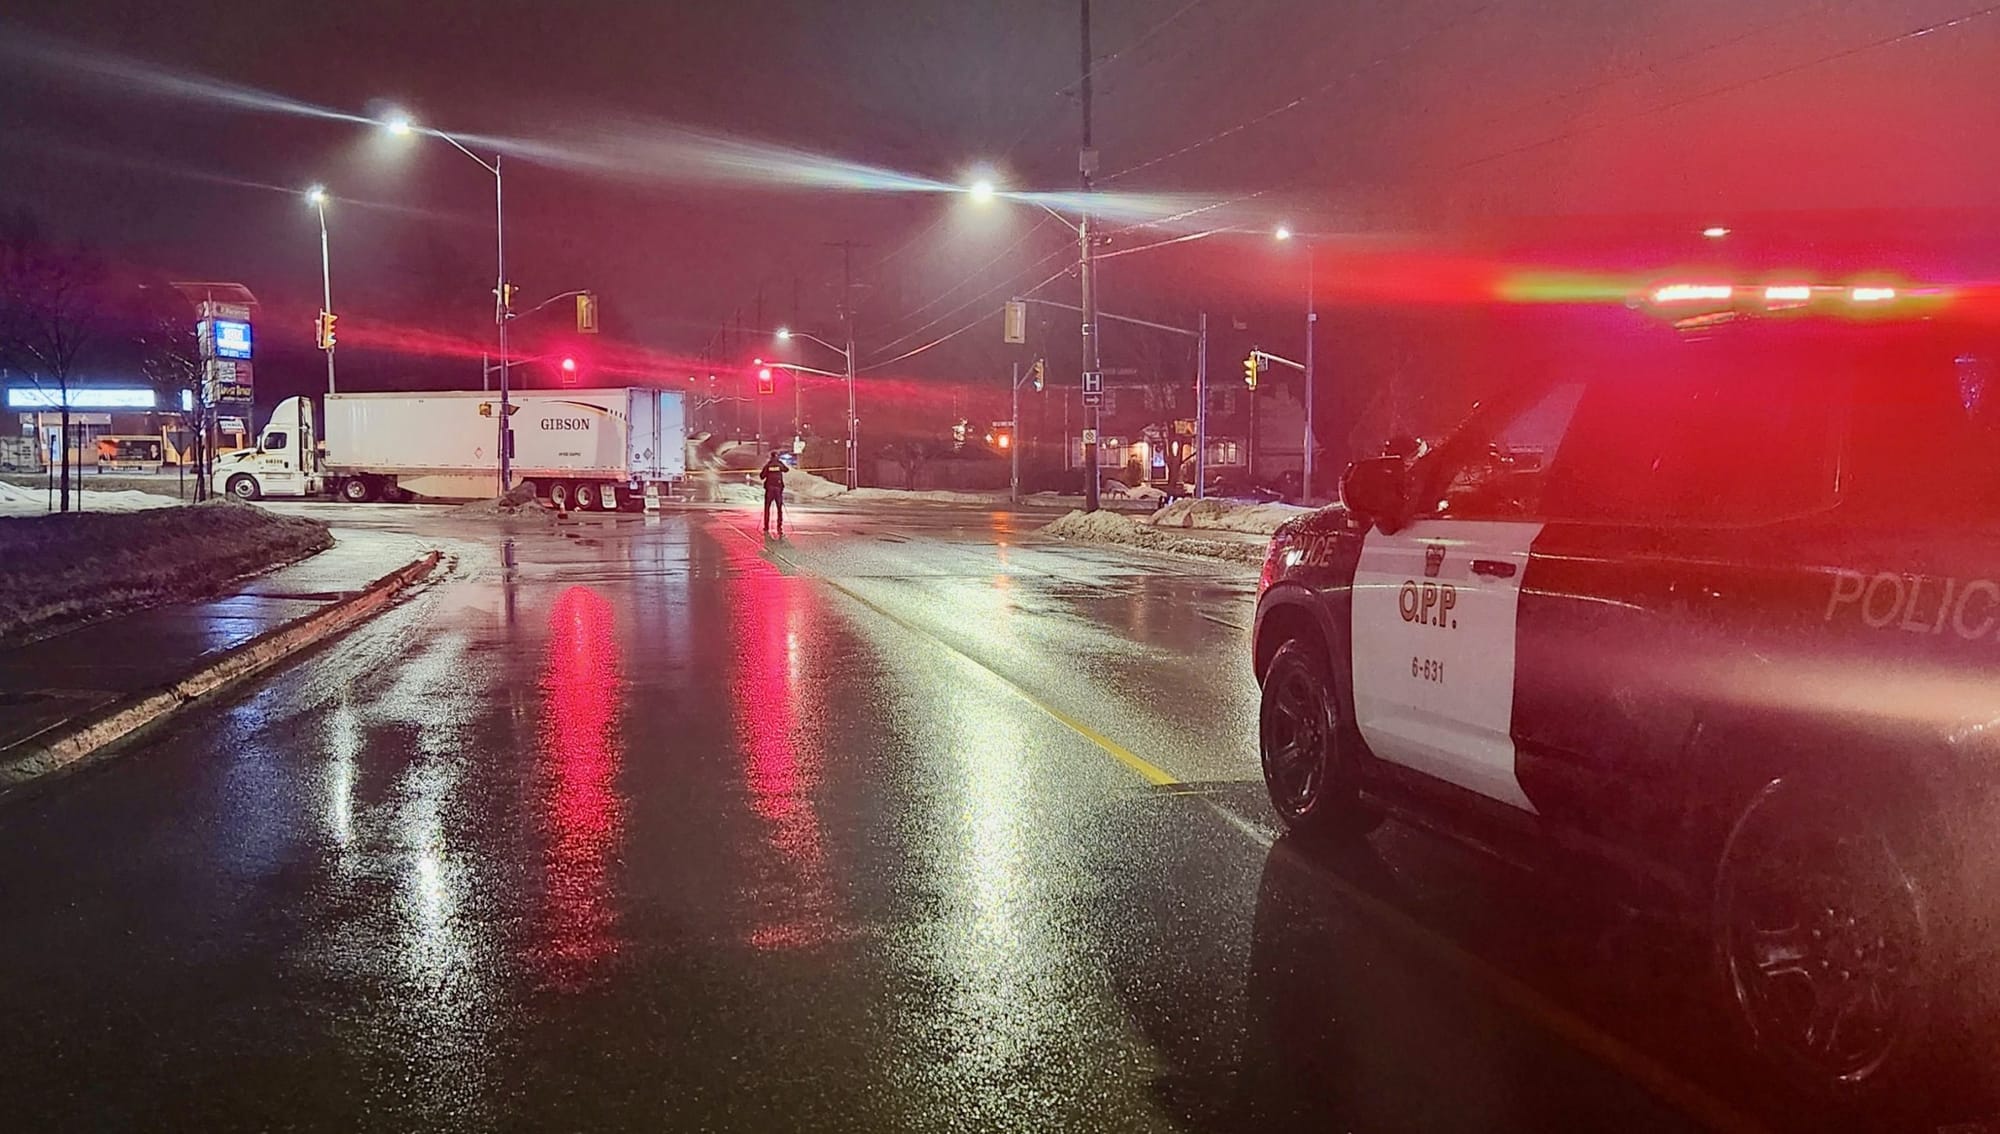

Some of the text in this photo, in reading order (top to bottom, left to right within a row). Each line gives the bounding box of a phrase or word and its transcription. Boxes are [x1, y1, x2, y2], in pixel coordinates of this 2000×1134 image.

[1085, 372, 1100, 391] H
[541, 418, 590, 431] GIBSON
[1399, 580, 1457, 630] O.P.P.
[1824, 571, 2000, 641] POLIC
[1411, 656, 1444, 684] 6-631
